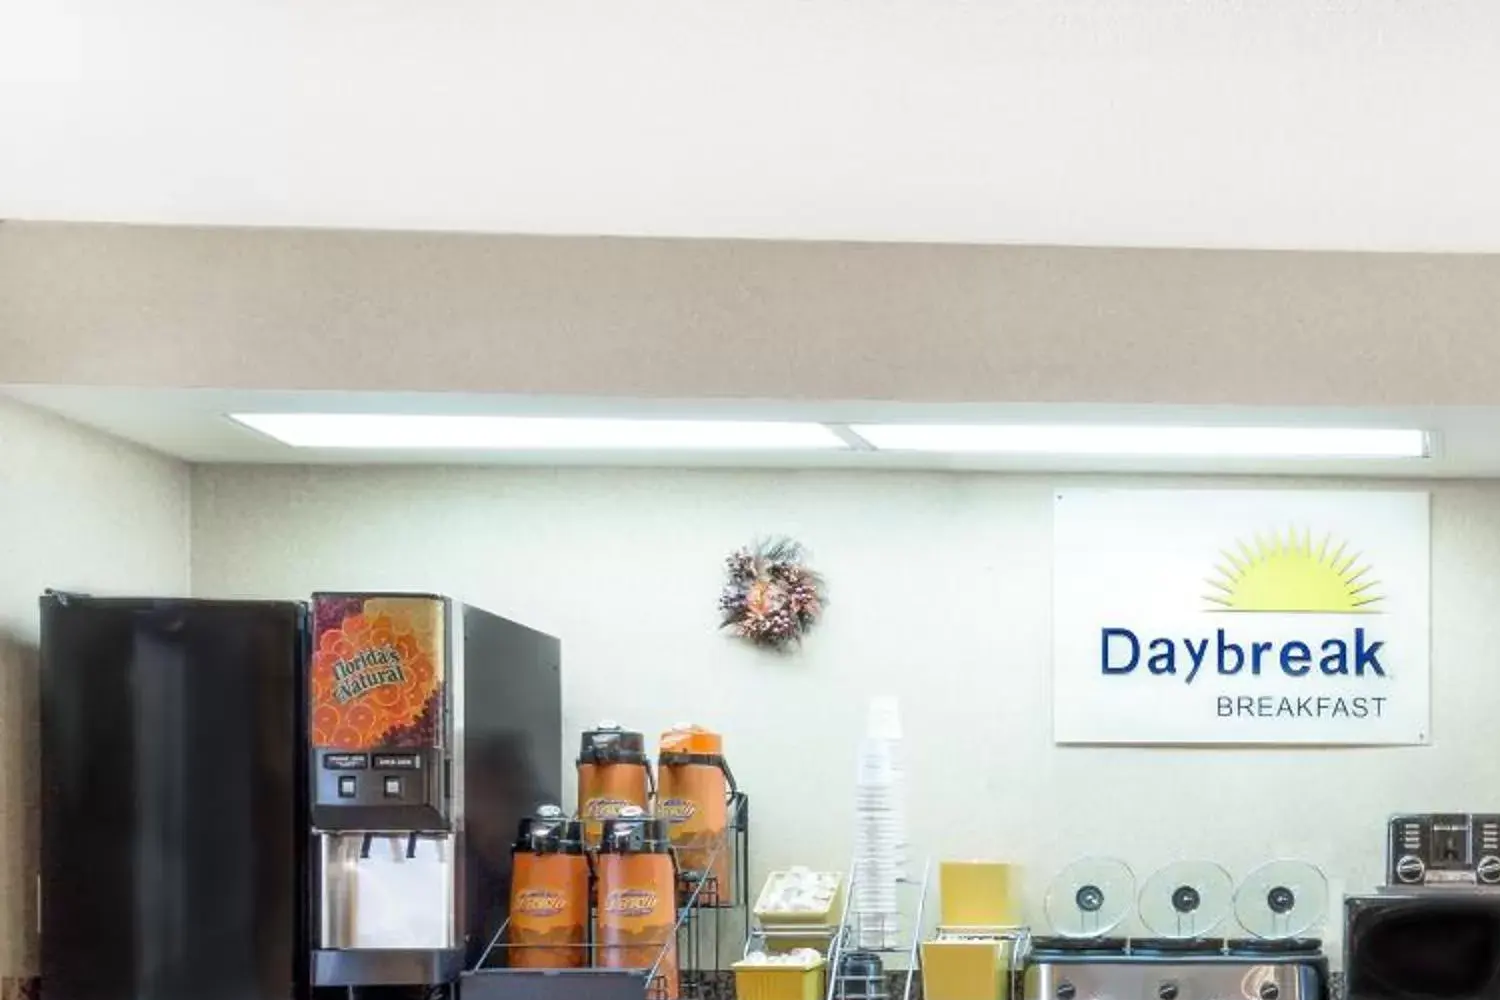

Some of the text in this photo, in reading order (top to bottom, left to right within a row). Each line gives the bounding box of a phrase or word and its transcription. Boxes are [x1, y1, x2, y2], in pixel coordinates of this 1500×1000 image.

[333, 645, 400, 681] Florida's
[1101, 627, 1387, 684] Daybreak
[333, 664, 405, 703] Natural
[1216, 696, 1387, 718] BREAKFAST
